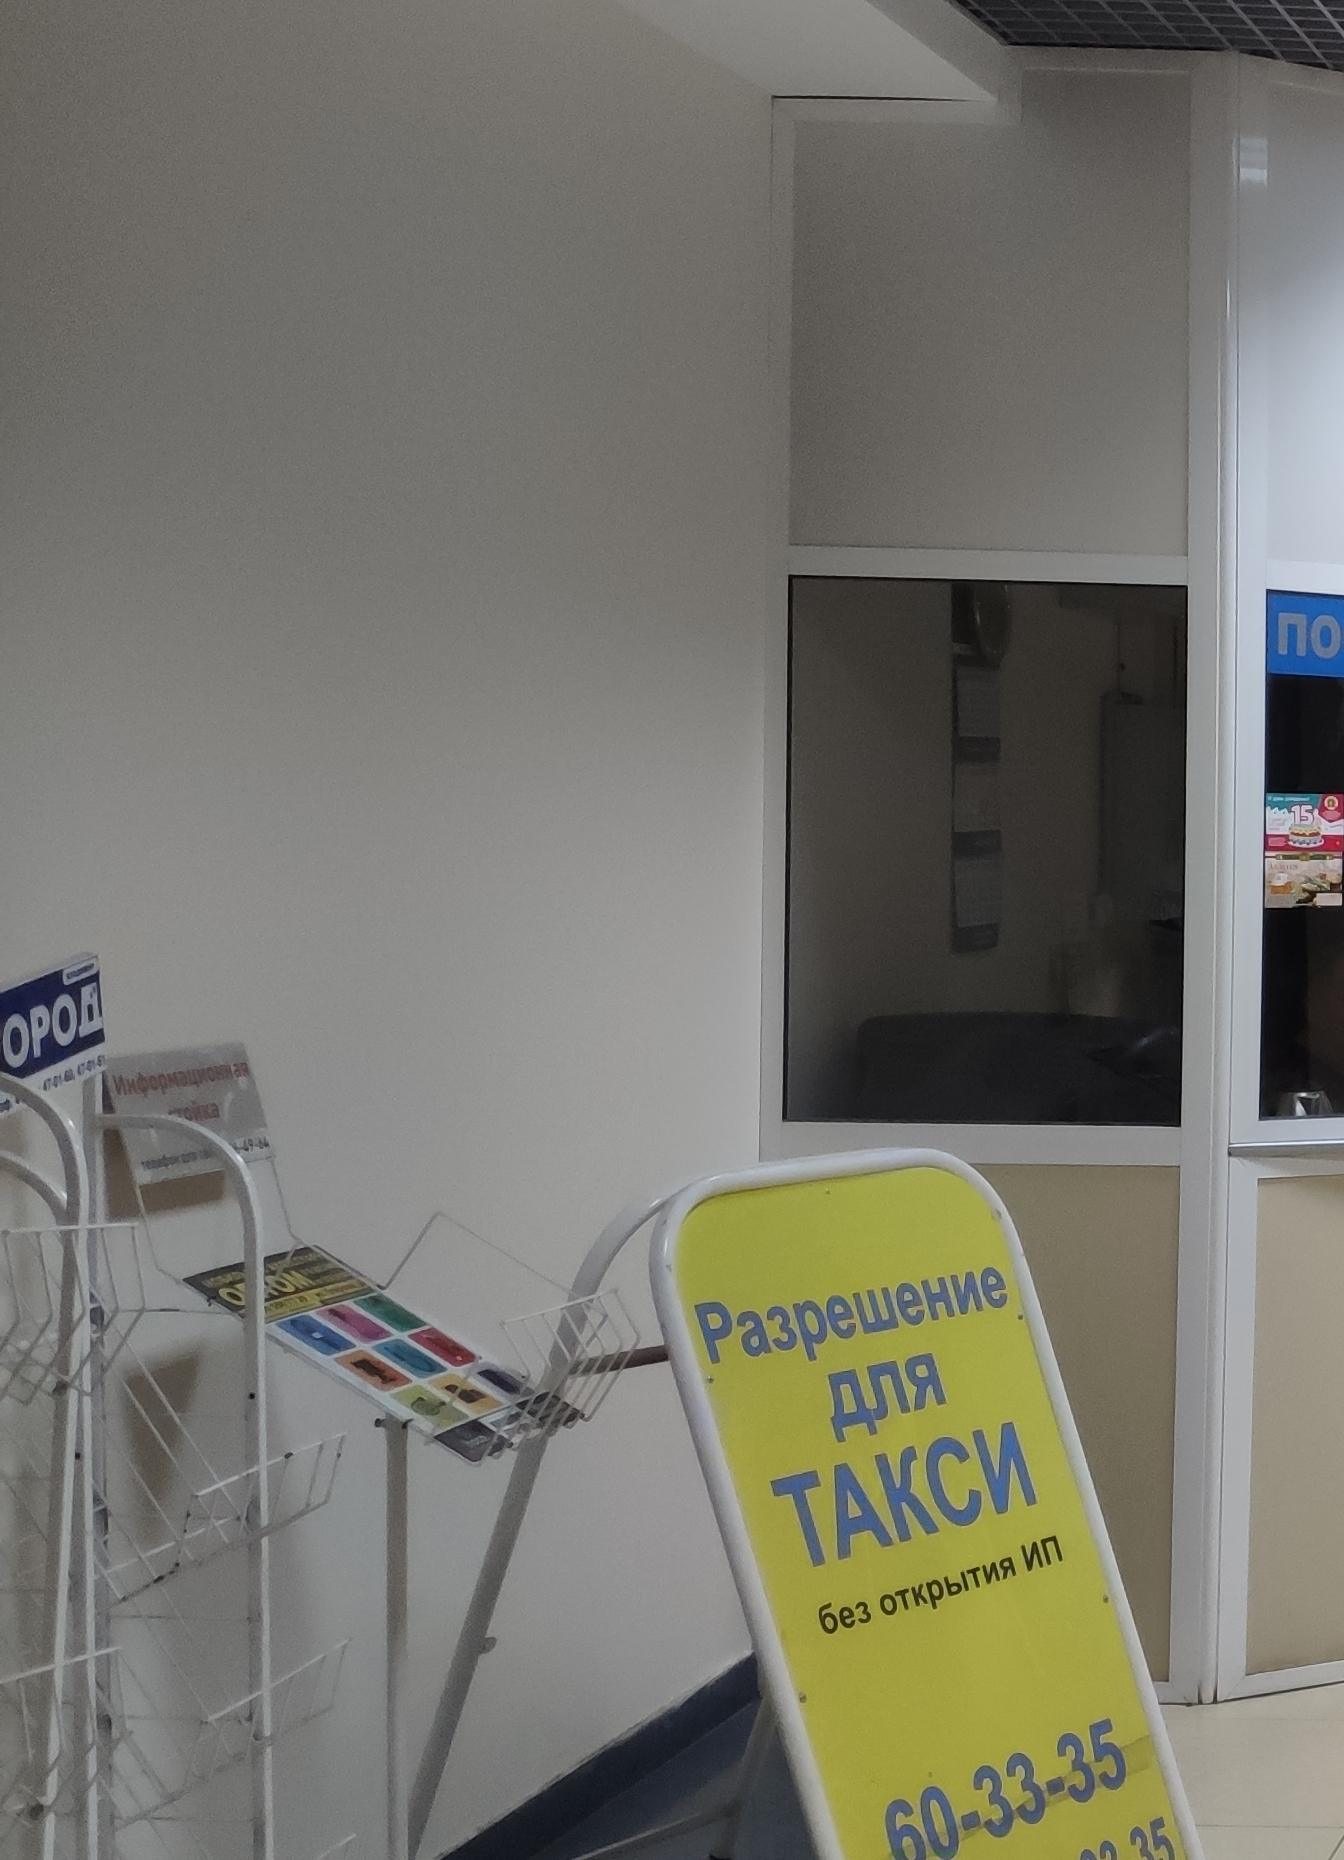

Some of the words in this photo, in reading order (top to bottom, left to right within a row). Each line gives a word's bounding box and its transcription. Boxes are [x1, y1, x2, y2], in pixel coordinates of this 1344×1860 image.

[1290, 804, 1315, 825] 15
[694, 1266, 1009, 1365] Разрешение
[827, 1352, 947, 1443] для
[769, 1421, 1038, 1568] ТАКСИ
[817, 1602, 872, 1635] без
[879, 1556, 1017, 1617] открытия
[1020, 1535, 1064, 1573] ИП
[885, 1718, 1127, 1860] 60-33-35
